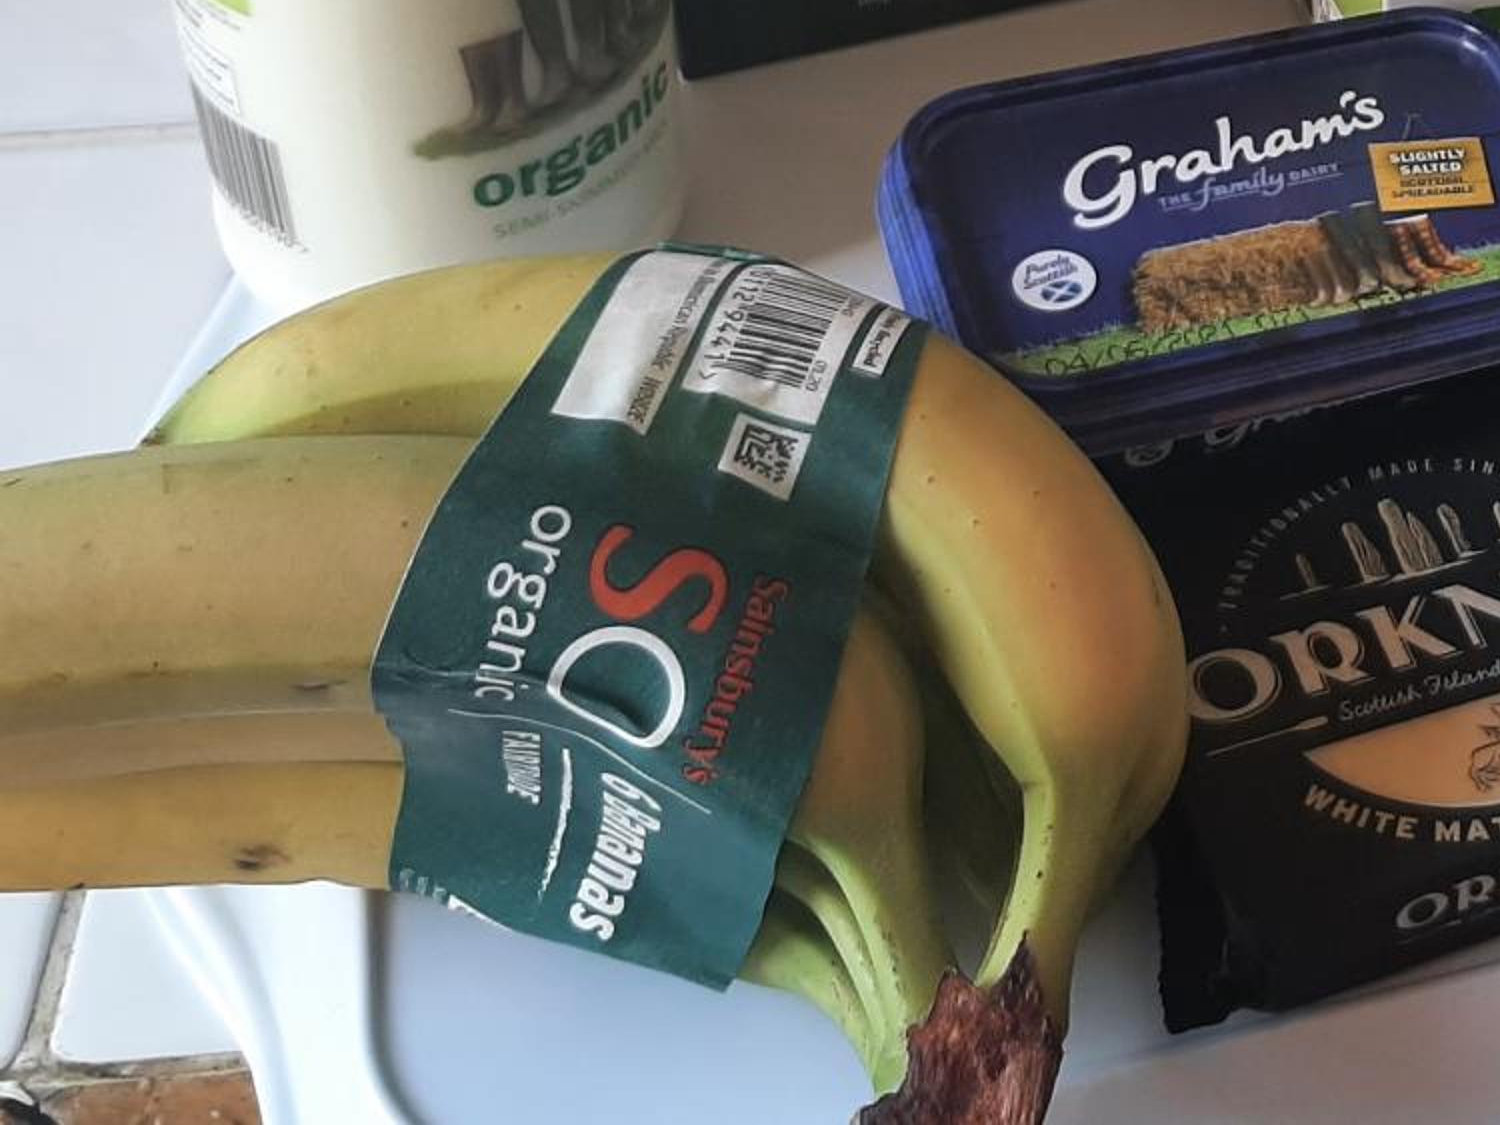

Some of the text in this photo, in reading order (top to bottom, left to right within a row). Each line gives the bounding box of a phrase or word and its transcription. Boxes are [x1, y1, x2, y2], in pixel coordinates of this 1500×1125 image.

[474, 61, 669, 208] organic
[1062, 89, 1386, 231] Graham's
[1388, 148, 1465, 164] SLIGHTLY
[1399, 161, 1462, 176] SALTED
[1157, 193, 1193, 211] THE
[1190, 165, 1285, 212] family
[1368, 458, 1436, 480] MADE
[473, 504, 572, 702] organic
[546, 522, 730, 750] SO
[681, 574, 790, 786] Sainsbury's
[1339, 686, 1423, 722] Scottish
[568, 771, 663, 943] 6 Bananas
[1303, 784, 1418, 841] WHITE
